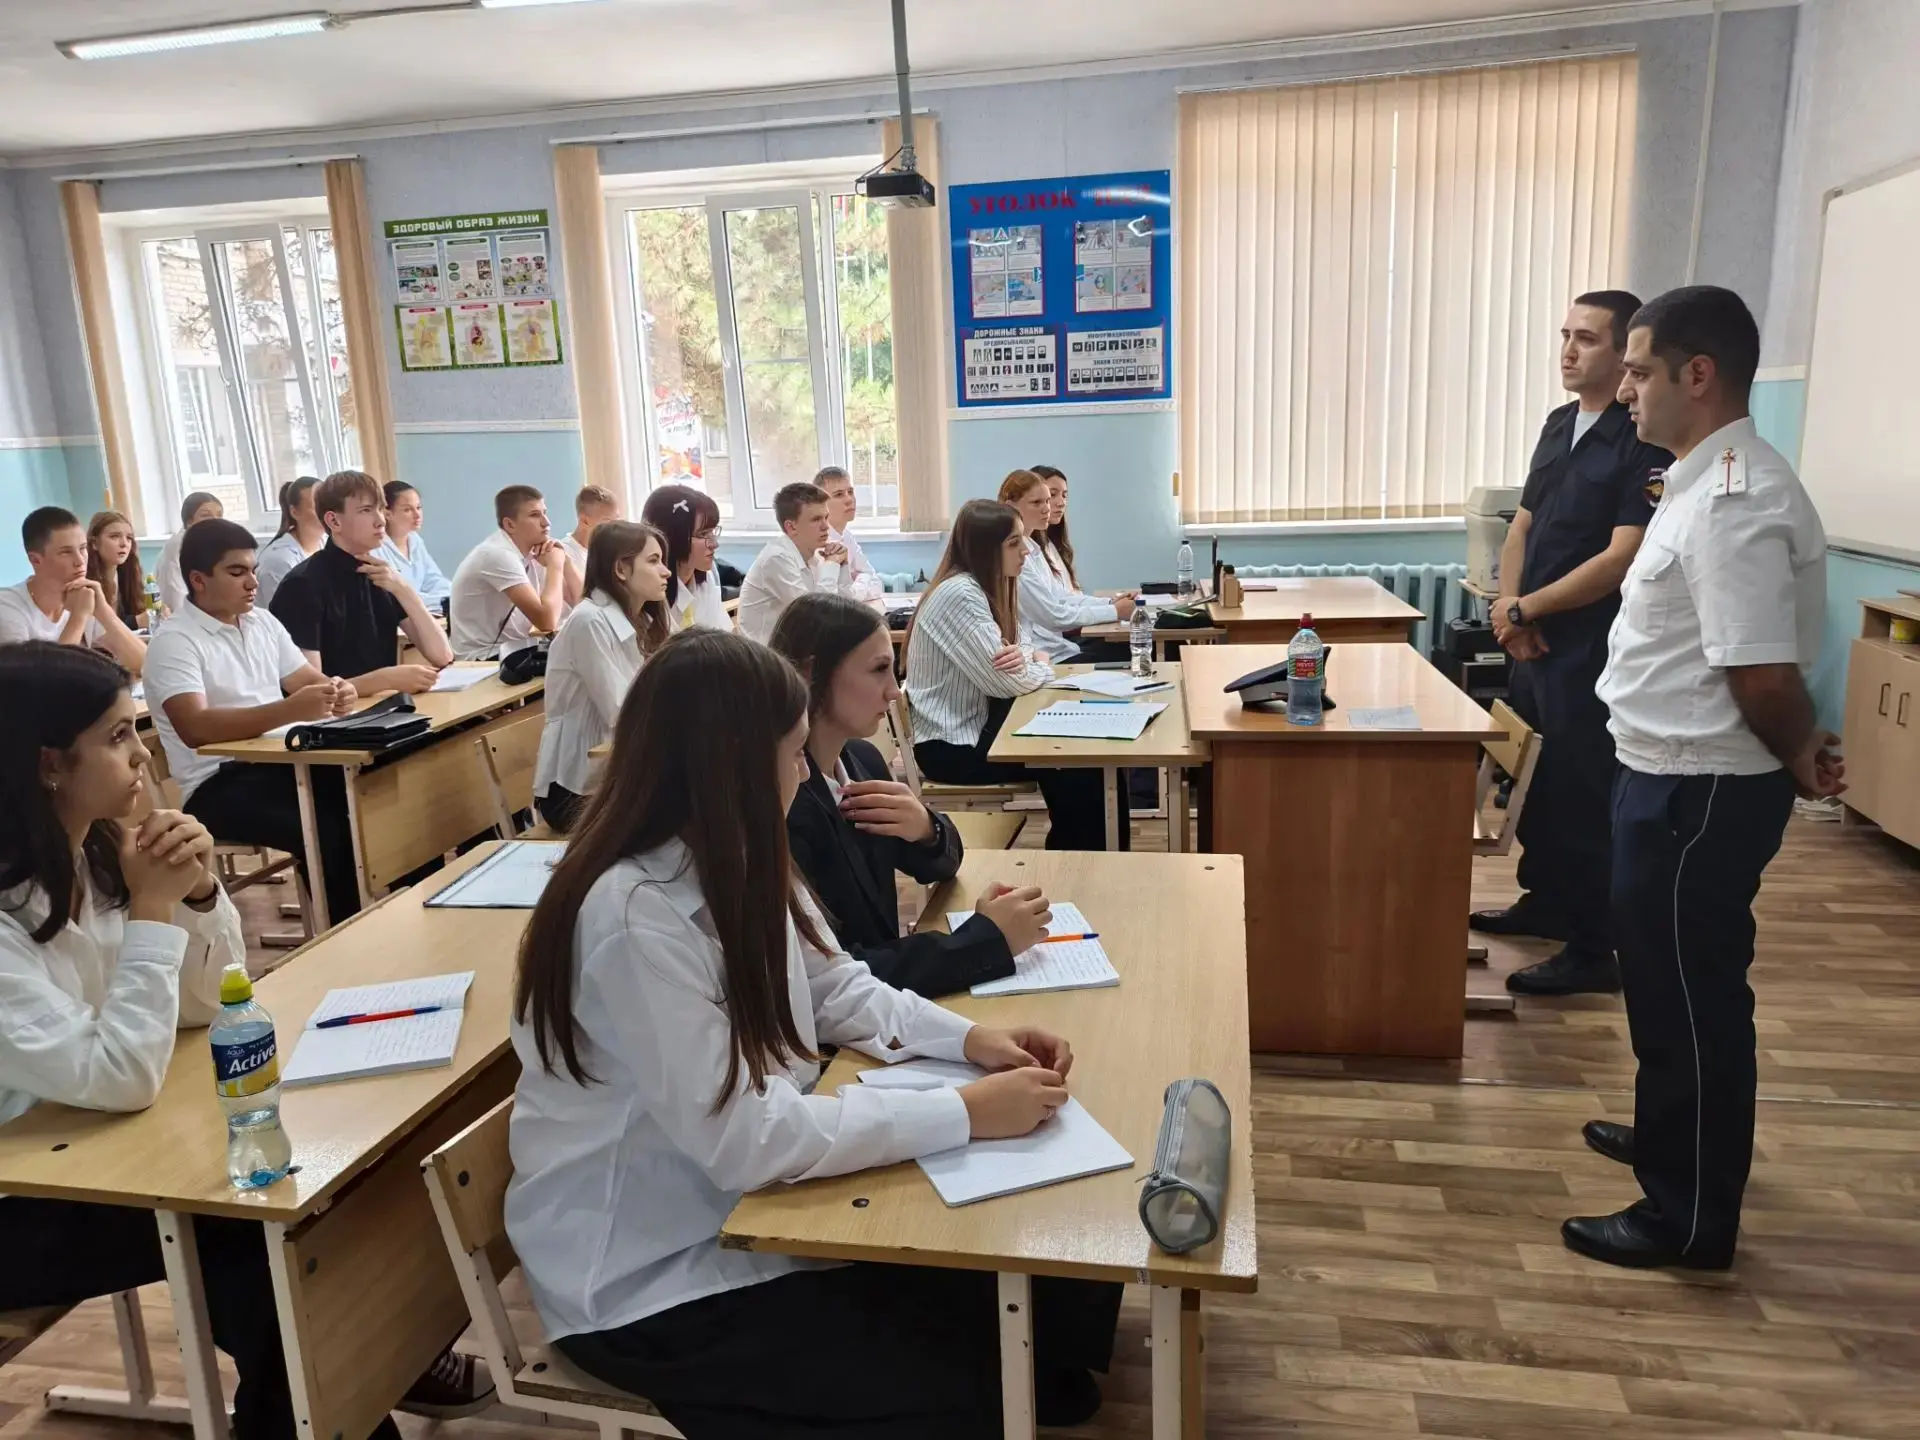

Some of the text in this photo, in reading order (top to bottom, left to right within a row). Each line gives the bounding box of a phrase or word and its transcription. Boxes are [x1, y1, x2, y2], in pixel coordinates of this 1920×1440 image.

[970, 191, 1077, 214] УГОЛОК
[392, 214, 540, 234] ЗДОРОВЫЙ ОБРАЗ ЖИЗНИ
[974, 326, 1044, 339] ДОРОЖНЫЕ ЗНАКИ
[228, 1044, 275, 1074] Active
